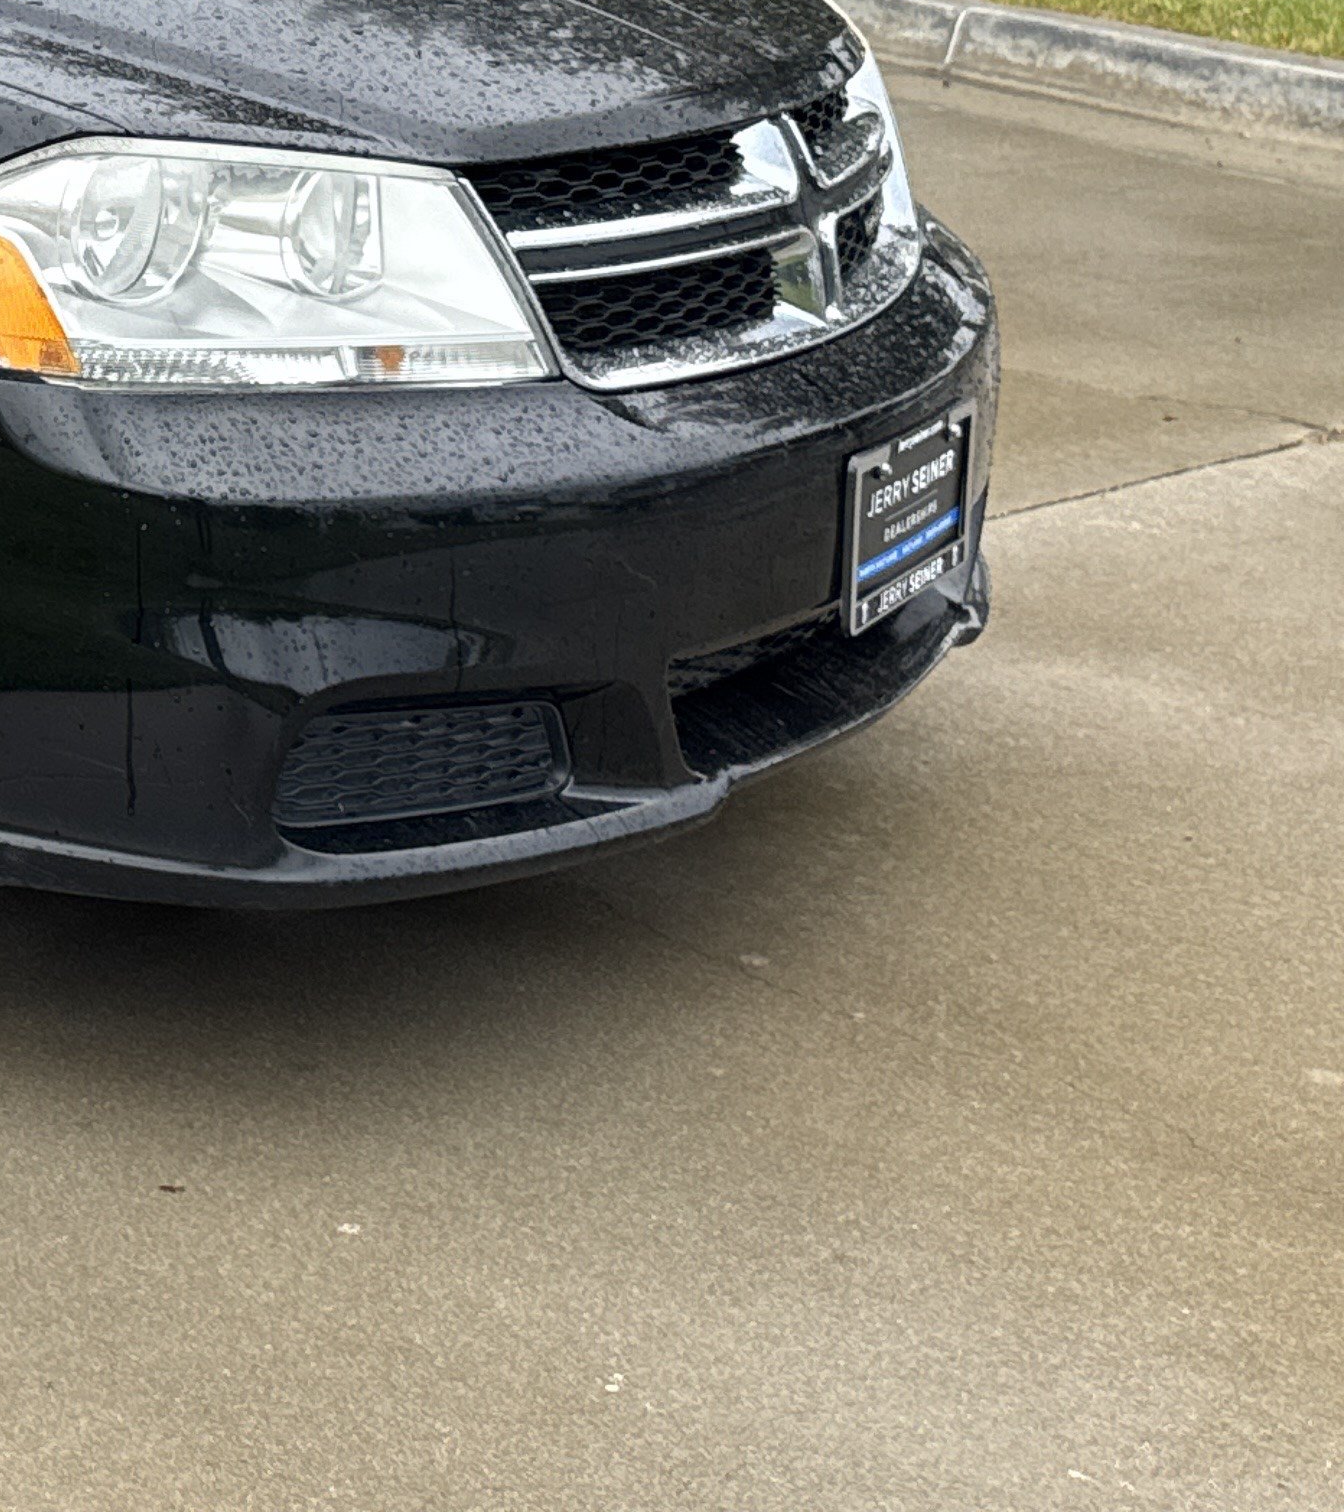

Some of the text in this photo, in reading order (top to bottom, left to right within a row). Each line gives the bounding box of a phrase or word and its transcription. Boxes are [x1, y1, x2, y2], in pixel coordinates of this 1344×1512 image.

[867, 449, 956, 518] JERRY SEINER
[877, 556, 944, 615] JERRY SEINER
